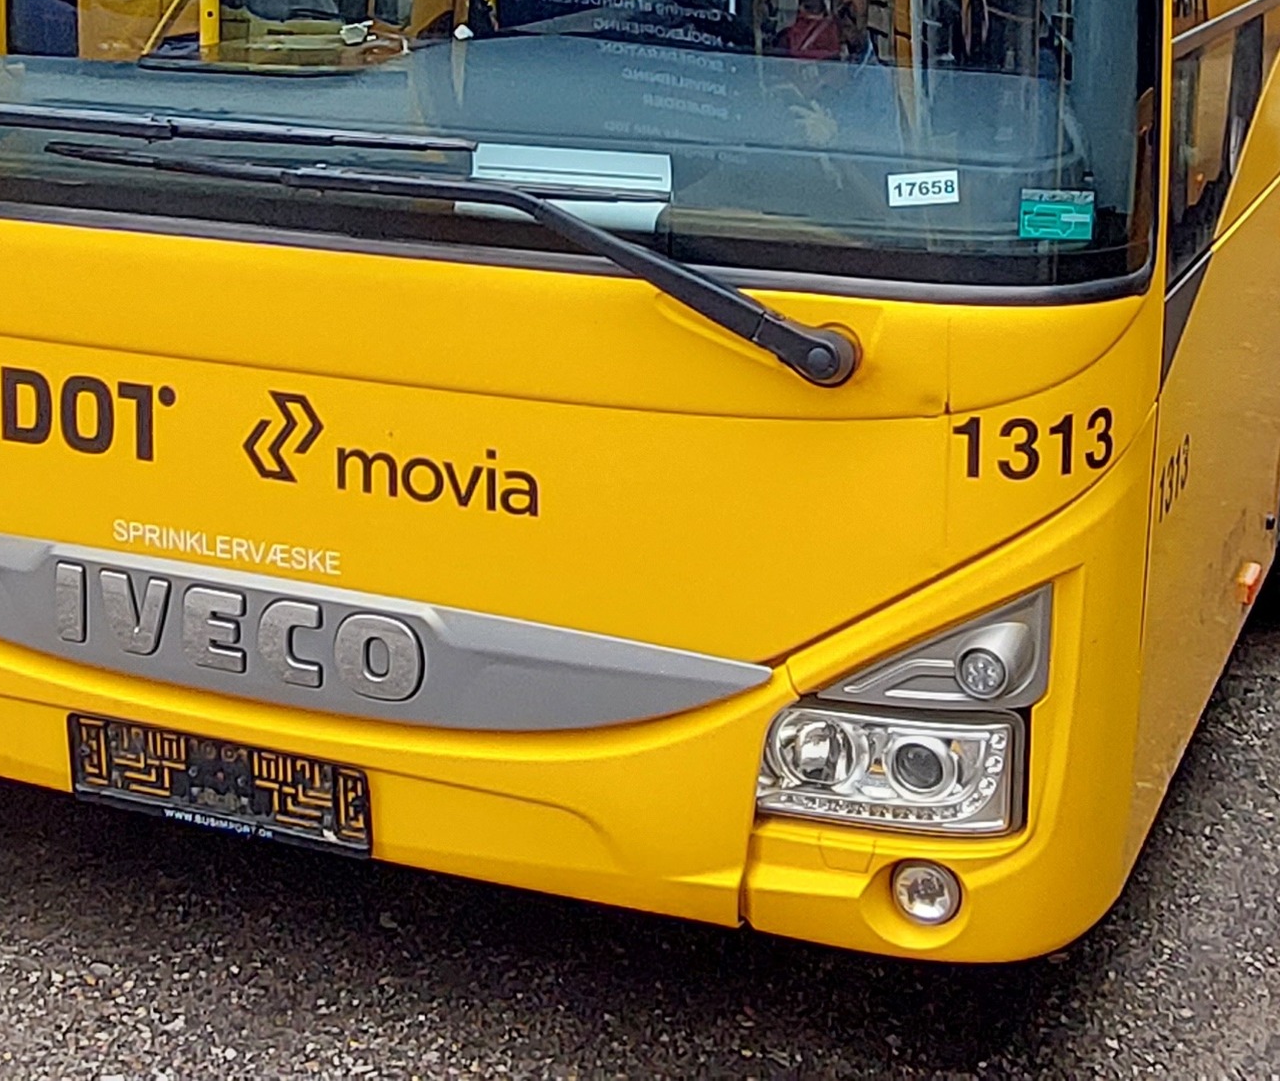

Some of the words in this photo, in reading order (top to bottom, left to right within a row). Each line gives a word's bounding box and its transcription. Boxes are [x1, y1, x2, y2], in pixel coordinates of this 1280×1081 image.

[893, 179, 956, 199] 17658
[1, 366, 175, 461] DOT
[952, 407, 1114, 481] 1313
[337, 448, 540, 518] movia
[1158, 434, 1191, 524] 1313
[112, 519, 342, 576] SPRINKLERVÆSKE
[54, 561, 426, 704] IVECO
